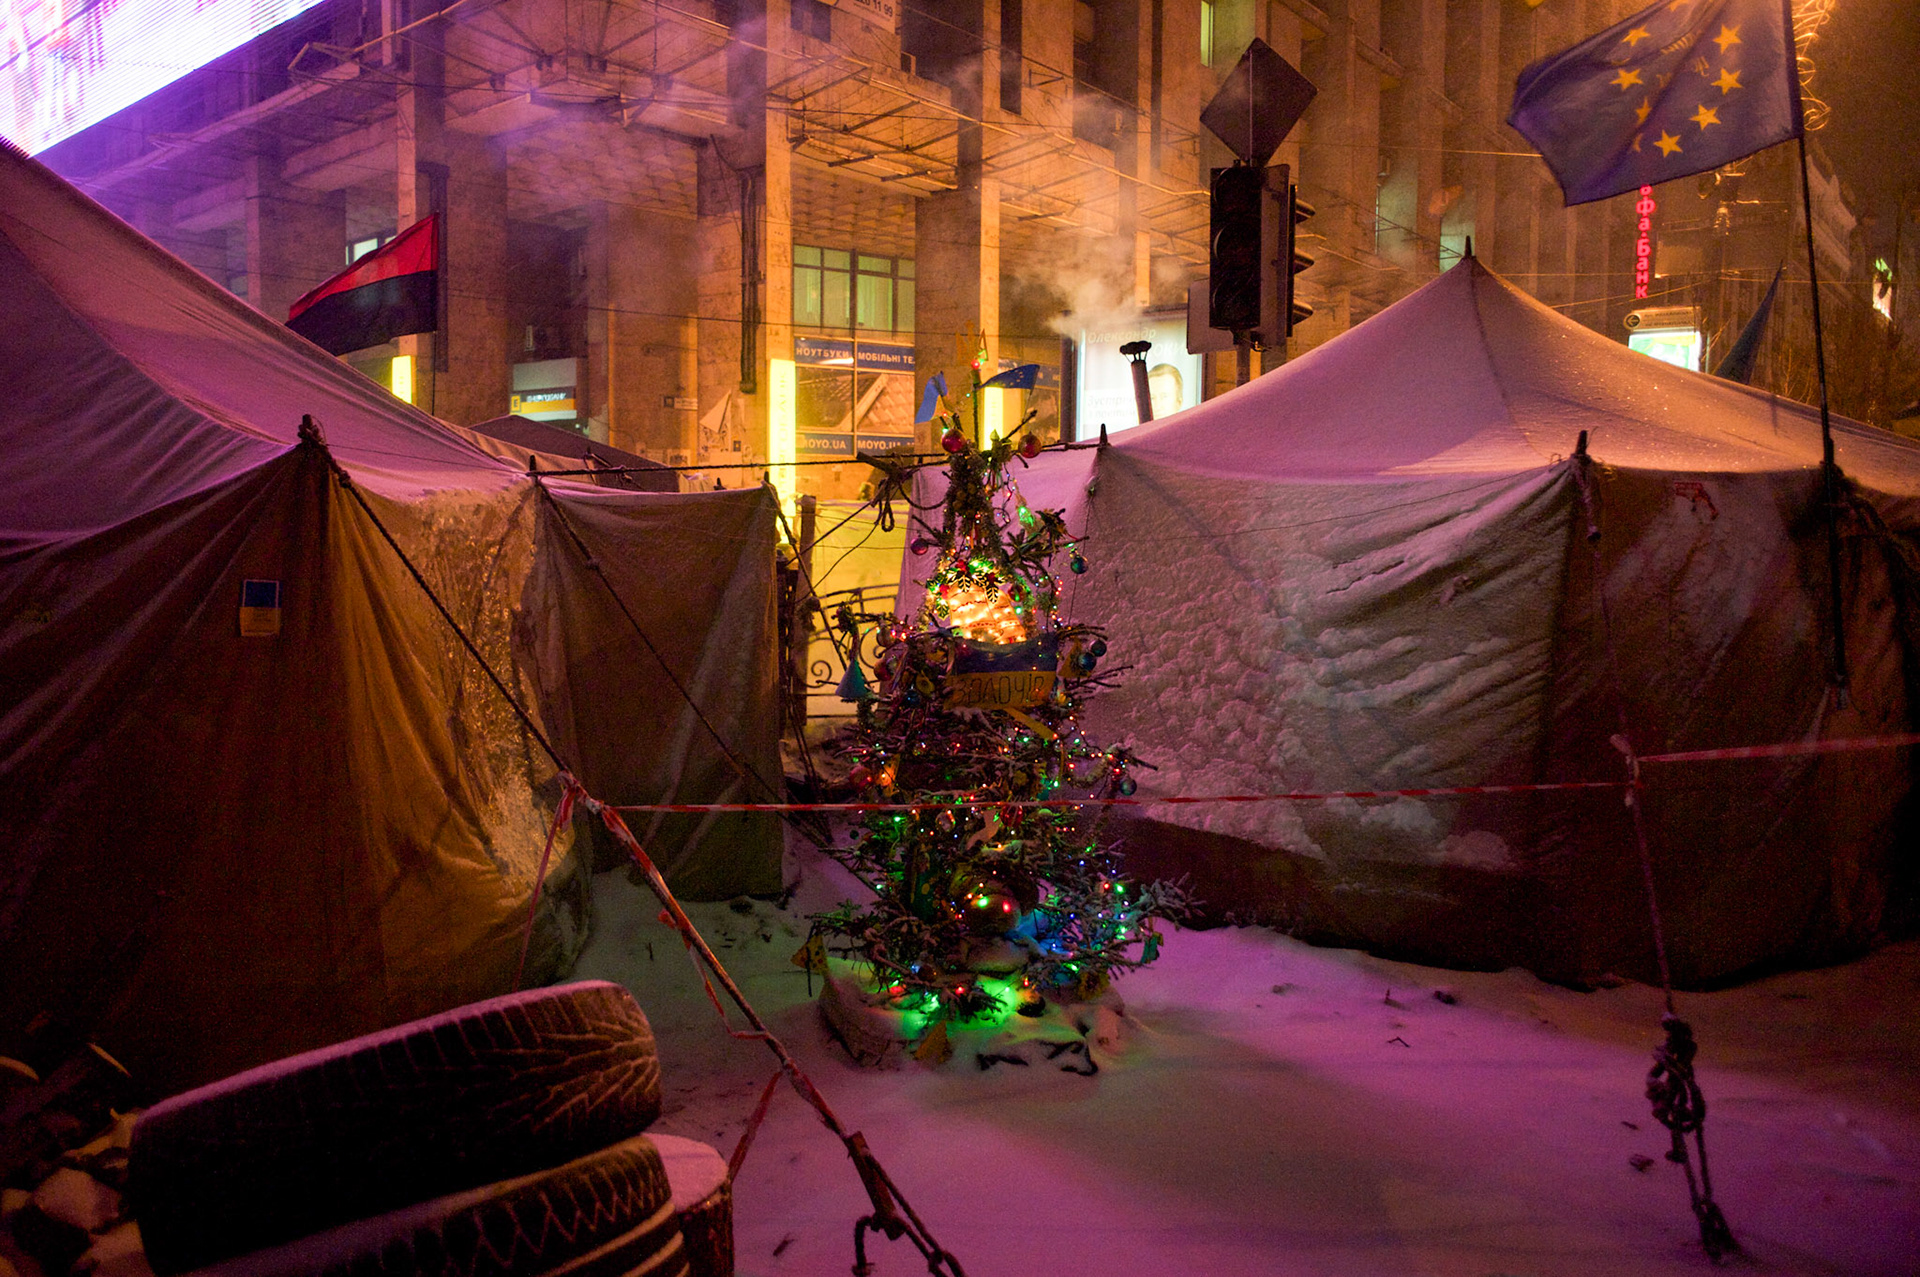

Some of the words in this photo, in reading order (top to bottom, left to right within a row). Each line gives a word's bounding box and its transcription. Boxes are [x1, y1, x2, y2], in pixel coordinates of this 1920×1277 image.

[884, 4, 893, 17] 99
[796, 348, 851, 359] НОУТБУКИ
[858, 351, 901, 363] МОБІЛЬНІ
[903, 355, 916, 365] ТЕ
